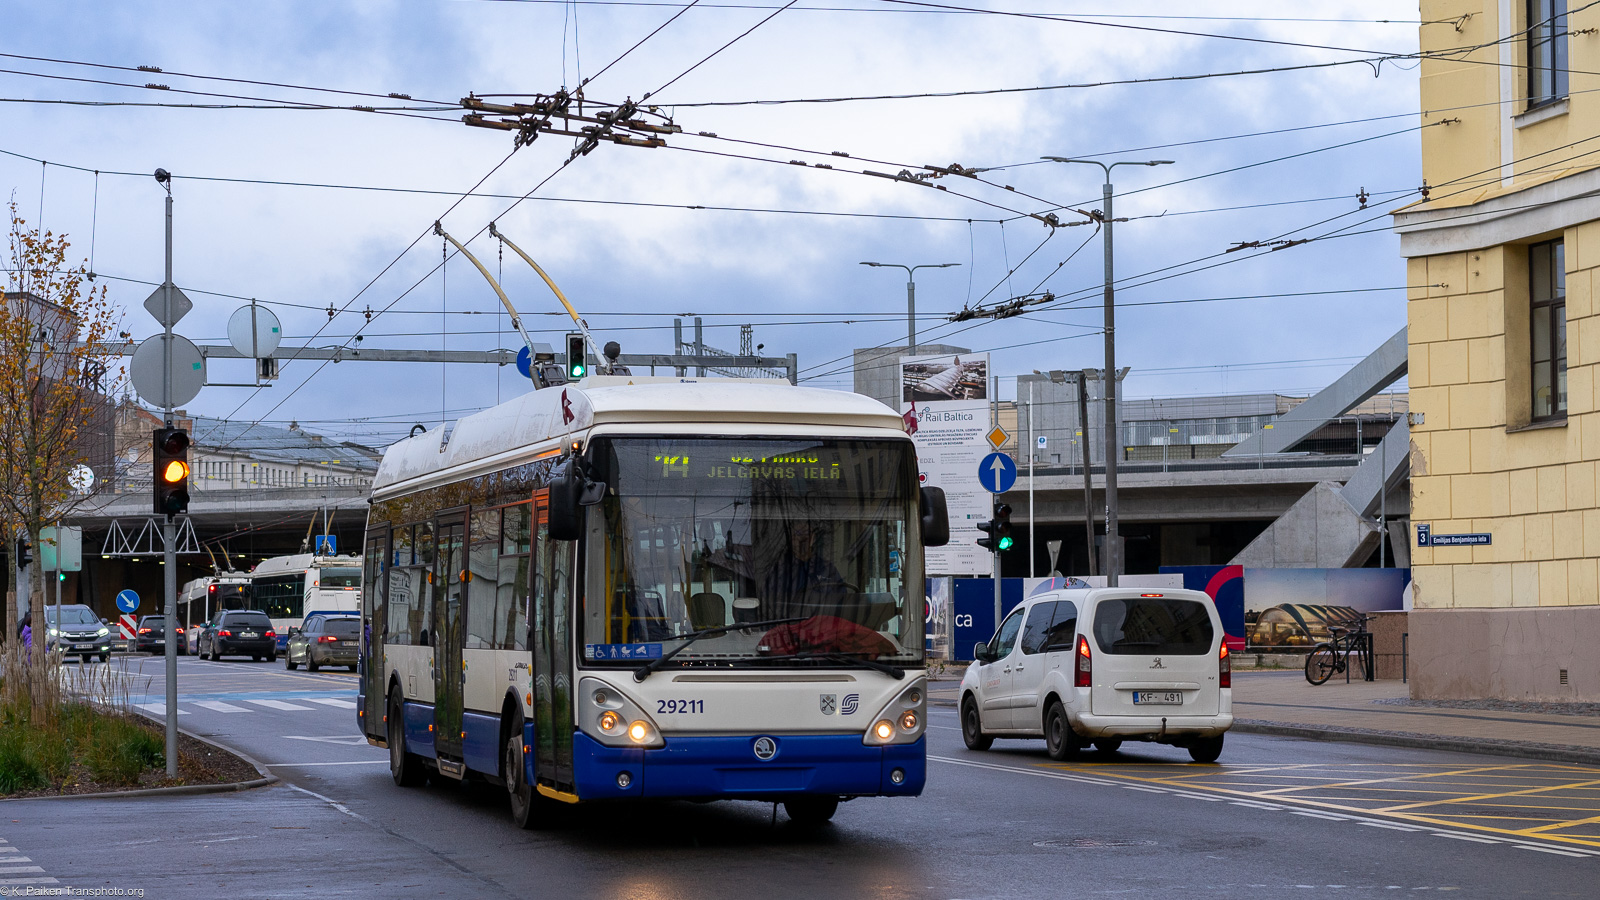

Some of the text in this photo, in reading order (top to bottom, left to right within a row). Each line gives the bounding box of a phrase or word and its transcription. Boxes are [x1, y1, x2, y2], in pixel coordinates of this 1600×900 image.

[925, 412, 973, 422] Rail Baltica
[655, 453, 689, 478] 14
[707, 464, 840, 478] JELGAVAS IELĀ
[1420, 533, 1426, 543] 3
[1164, 694, 1180, 702] 491
[657, 700, 704, 714] 29211
